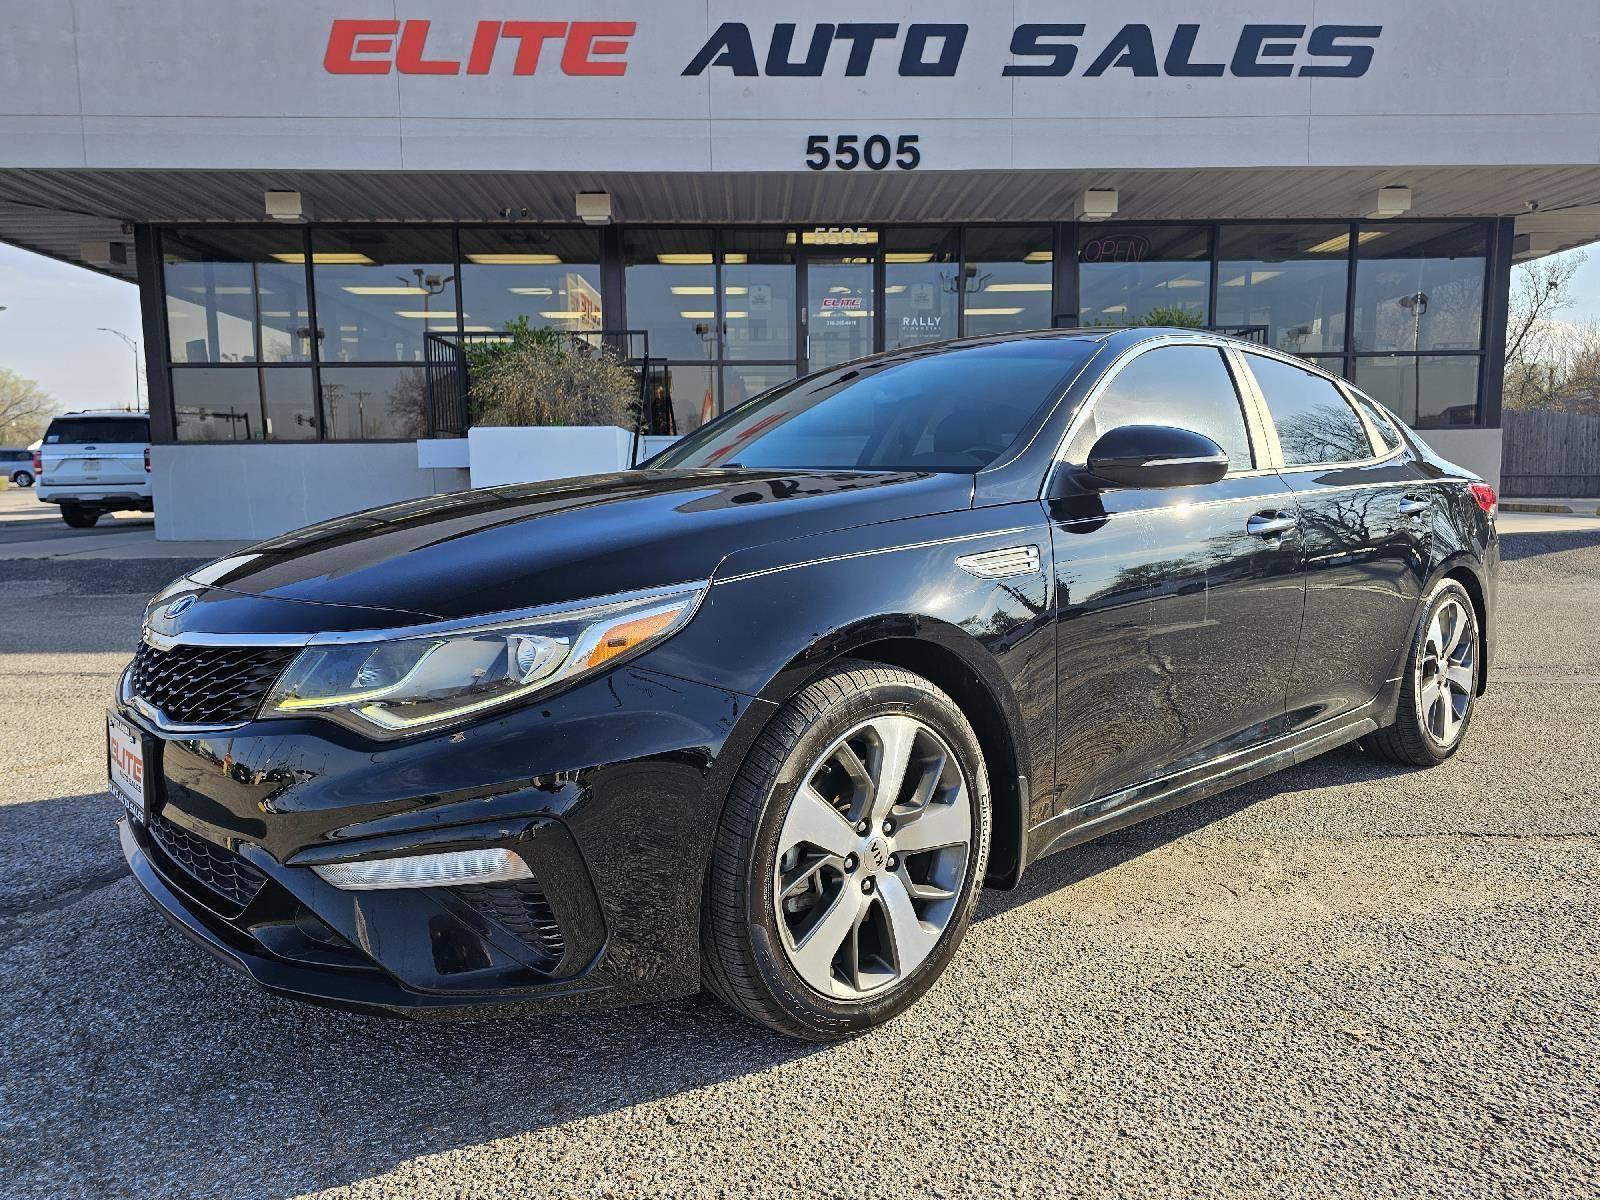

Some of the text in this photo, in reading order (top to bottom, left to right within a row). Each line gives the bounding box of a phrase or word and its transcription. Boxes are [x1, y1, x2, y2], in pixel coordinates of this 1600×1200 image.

[323, 20, 1383, 78] ELITE AUTO SALES
[806, 134, 920, 170] 5505
[814, 227, 868, 245] 5505
[1084, 240, 1145, 263] OPEN
[823, 297, 862, 307] ELITE
[903, 316, 941, 326] RALLY
[111, 736, 143, 784] ELITE
